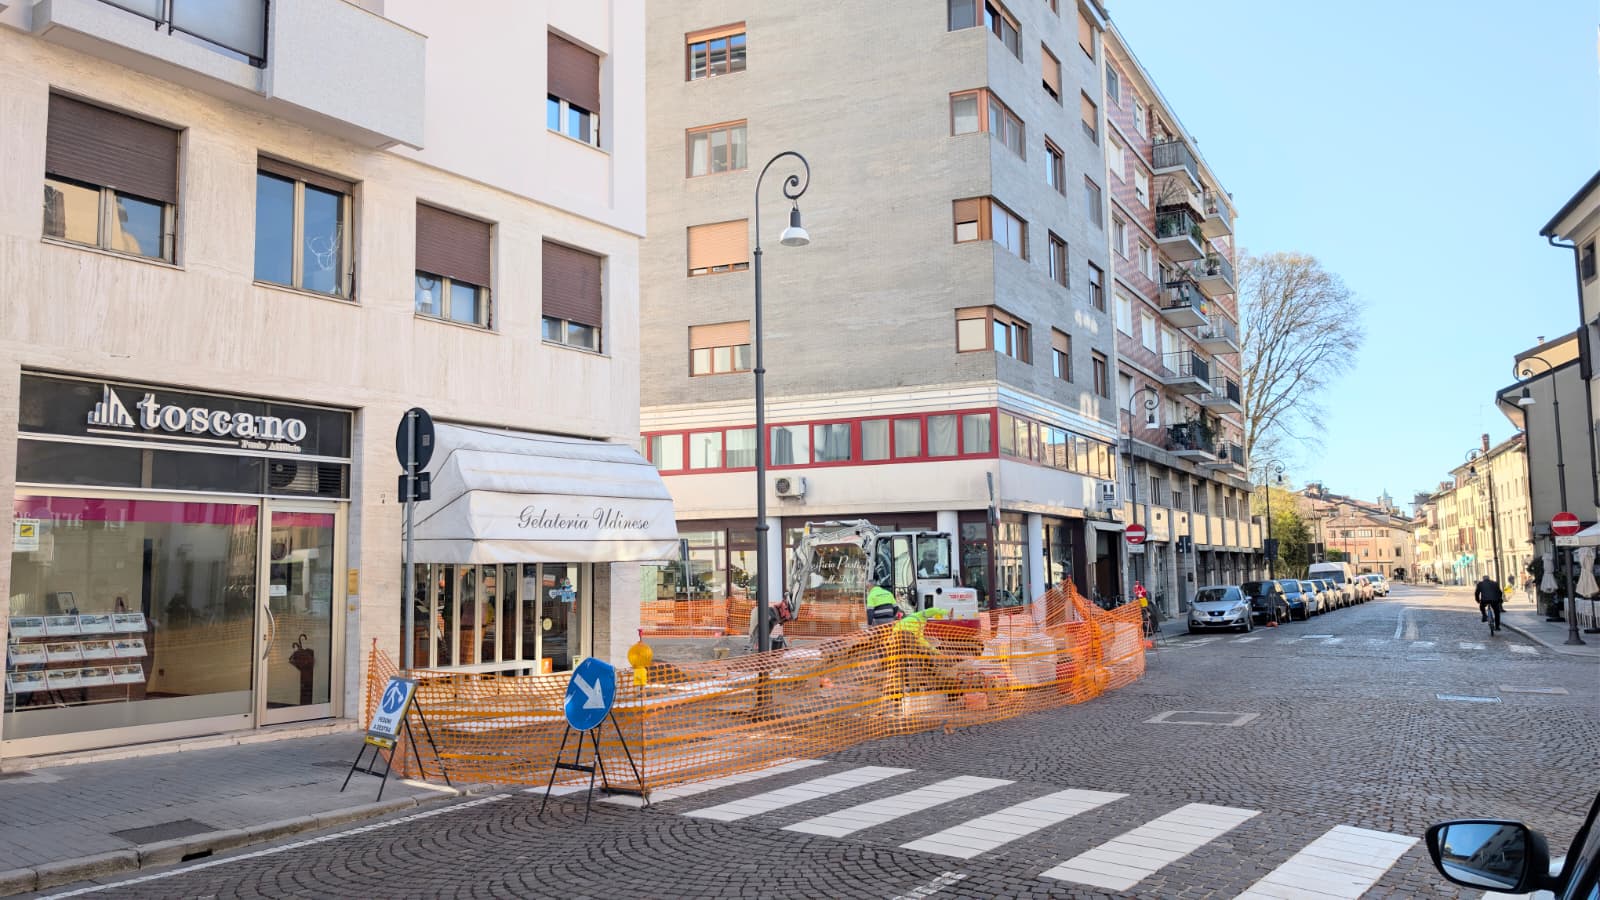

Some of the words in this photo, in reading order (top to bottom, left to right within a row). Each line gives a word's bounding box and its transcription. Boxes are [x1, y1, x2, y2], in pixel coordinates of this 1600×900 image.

[136, 393, 307, 442] toscano
[518, 505, 589, 529] Gelateria
[592, 507, 649, 530] Udinese
